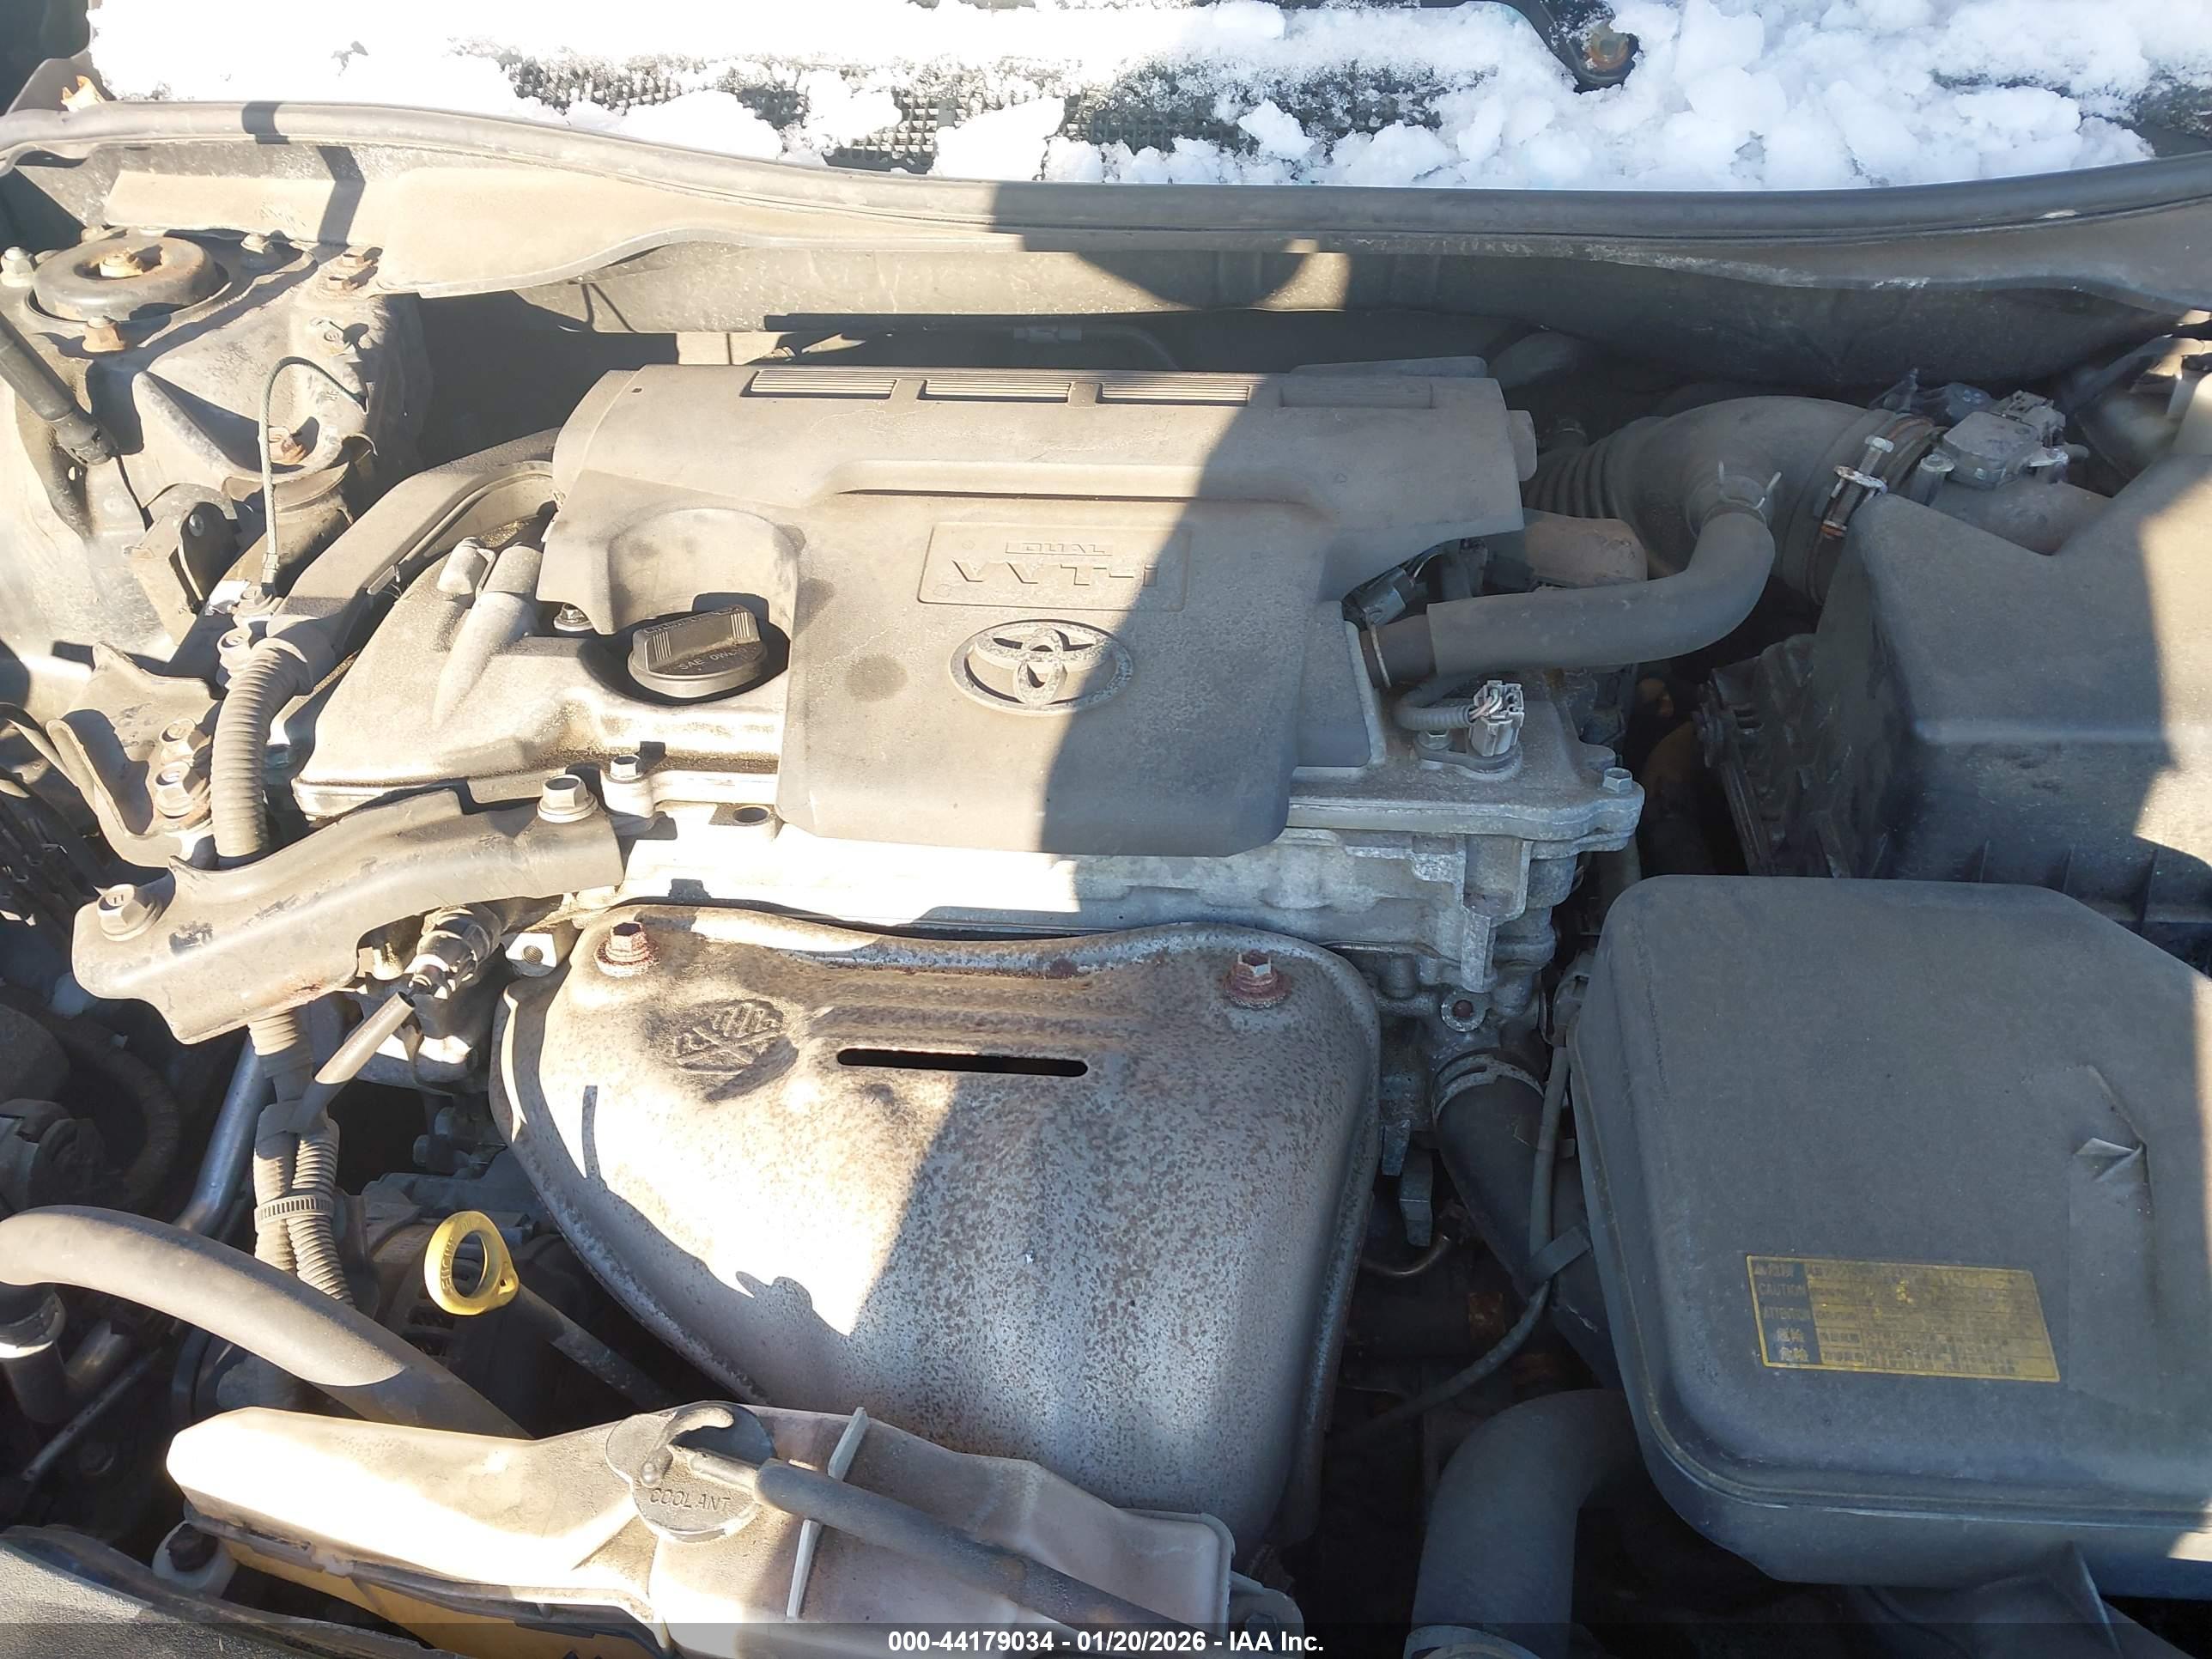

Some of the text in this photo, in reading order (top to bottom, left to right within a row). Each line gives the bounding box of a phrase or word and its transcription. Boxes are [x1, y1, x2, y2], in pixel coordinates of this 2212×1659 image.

[1022, 542, 1107, 555] DUAL
[951, 560, 1159, 586] VVT-i
[678, 658, 706, 671] SAE
[649, 1487, 732, 1512] COOLANT
